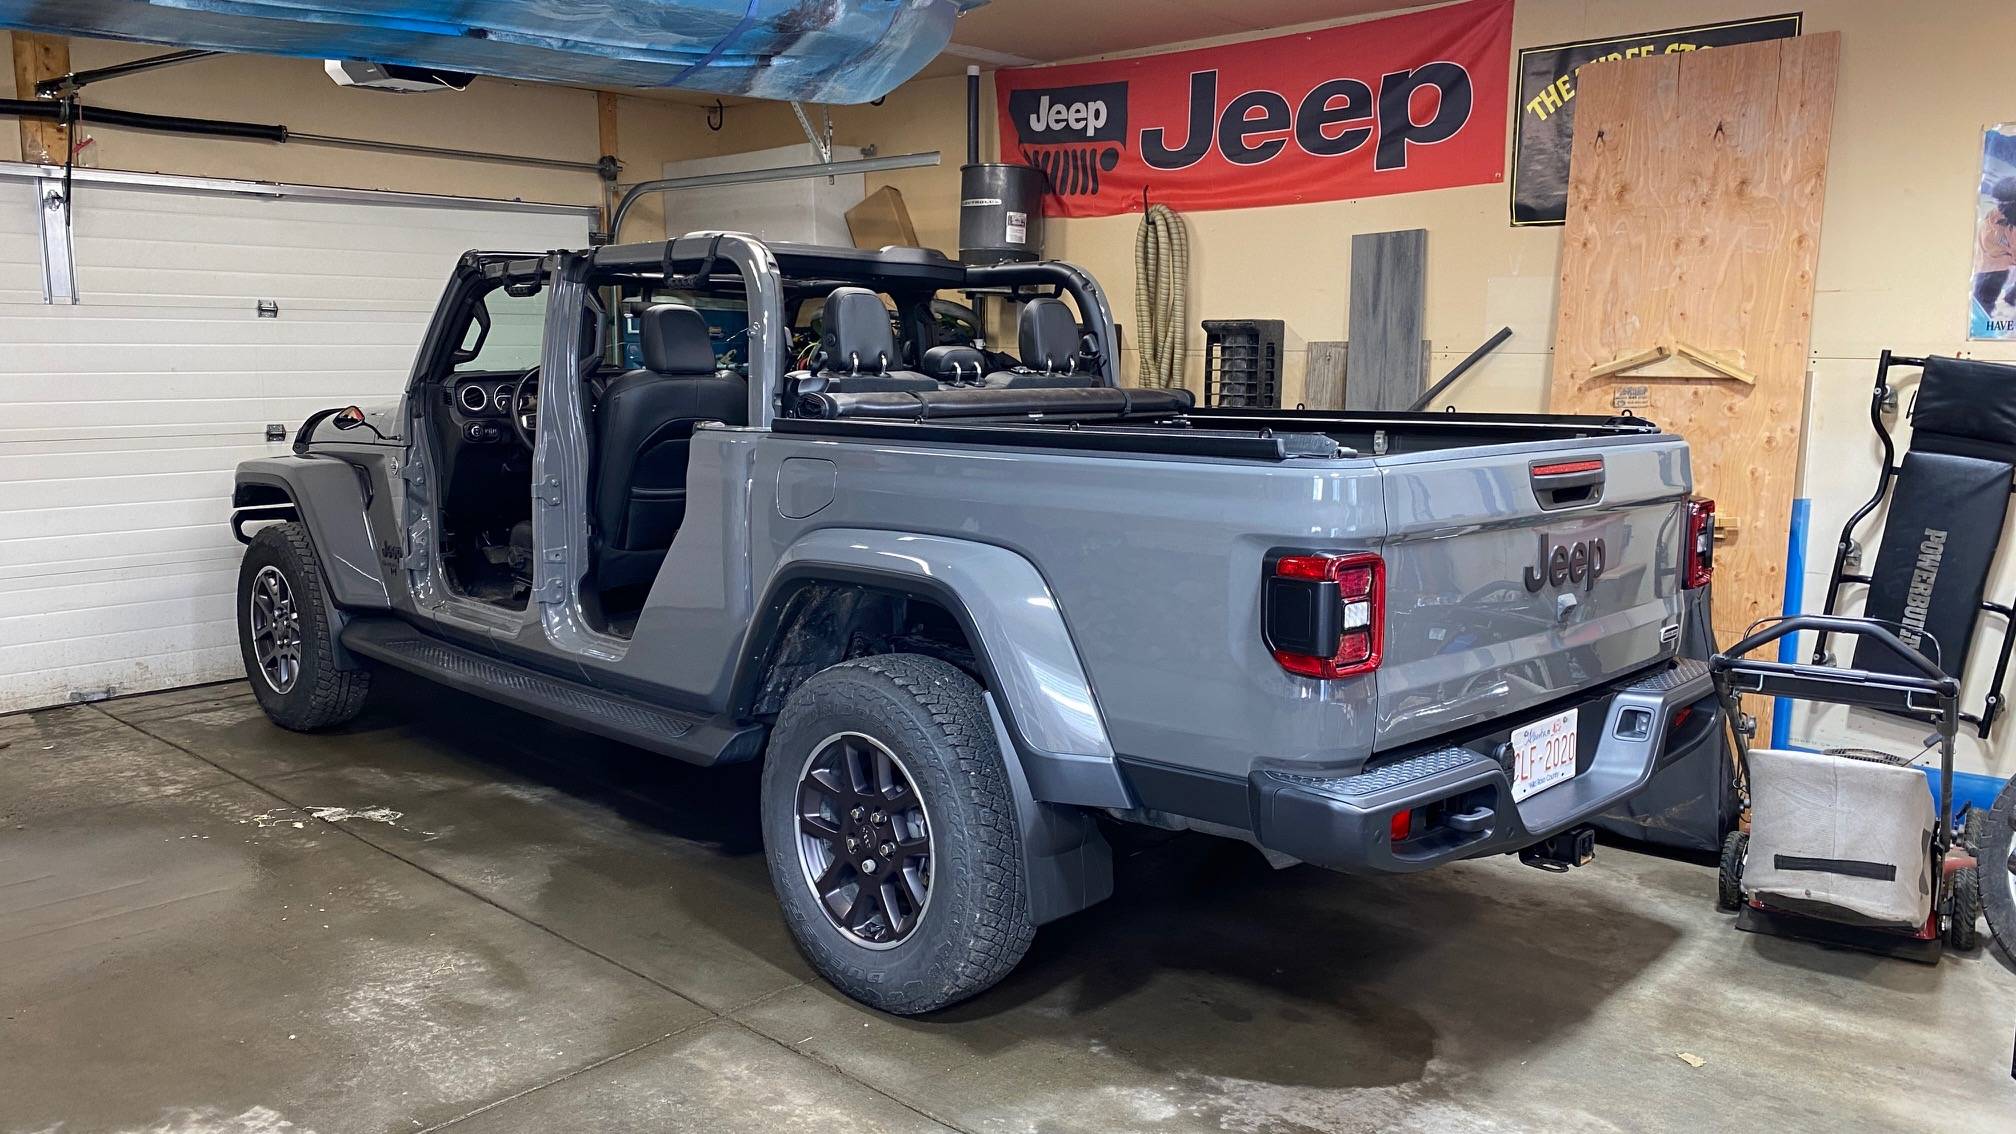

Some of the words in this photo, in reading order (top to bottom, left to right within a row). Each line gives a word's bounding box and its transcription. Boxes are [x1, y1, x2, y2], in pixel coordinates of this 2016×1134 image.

[1029, 95, 1107, 137] Jeep
[1140, 60, 1473, 172] Jeep
[1526, 75, 1576, 121] THE
[1986, 320, 2015, 331] HAVE
[1524, 532, 1607, 593] Jeep
